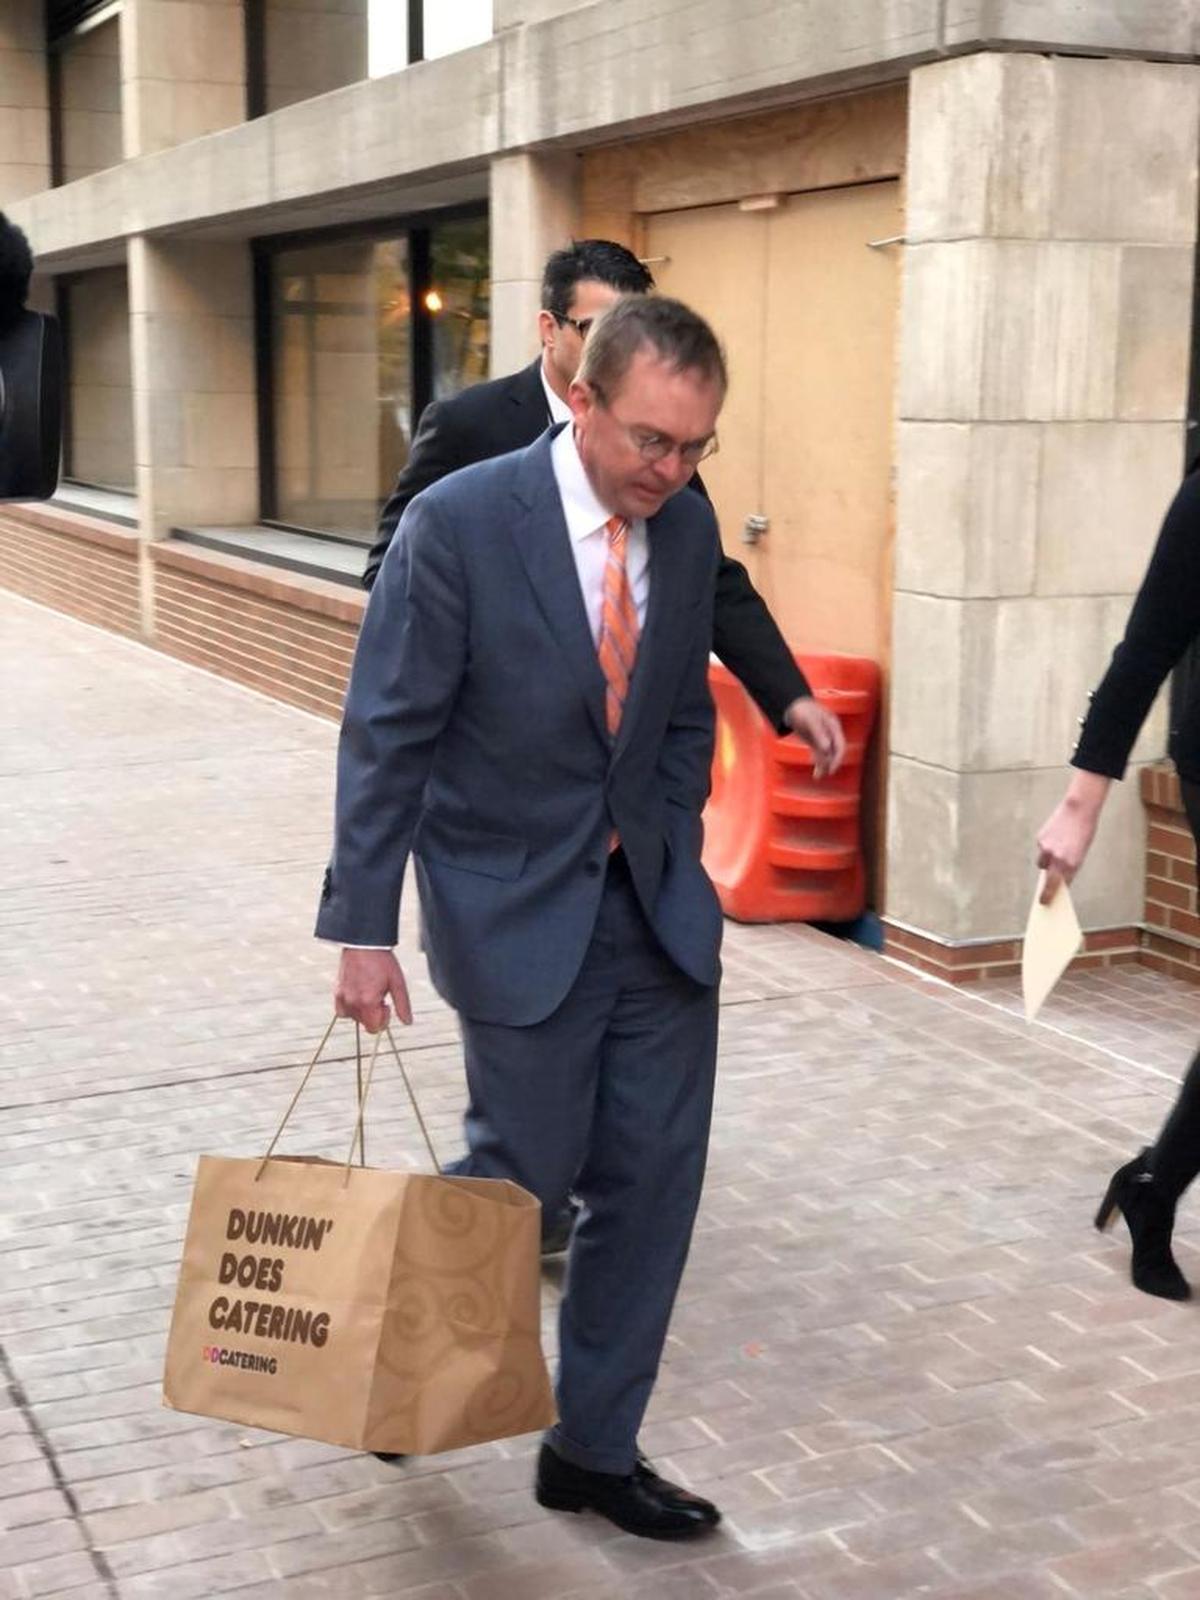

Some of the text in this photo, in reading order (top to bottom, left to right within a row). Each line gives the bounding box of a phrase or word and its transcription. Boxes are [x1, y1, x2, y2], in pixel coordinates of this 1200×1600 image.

[226, 1208, 333, 1251] DUNKIN'
[218, 1252, 284, 1292] DOES
[208, 1296, 331, 1348] CATERING
